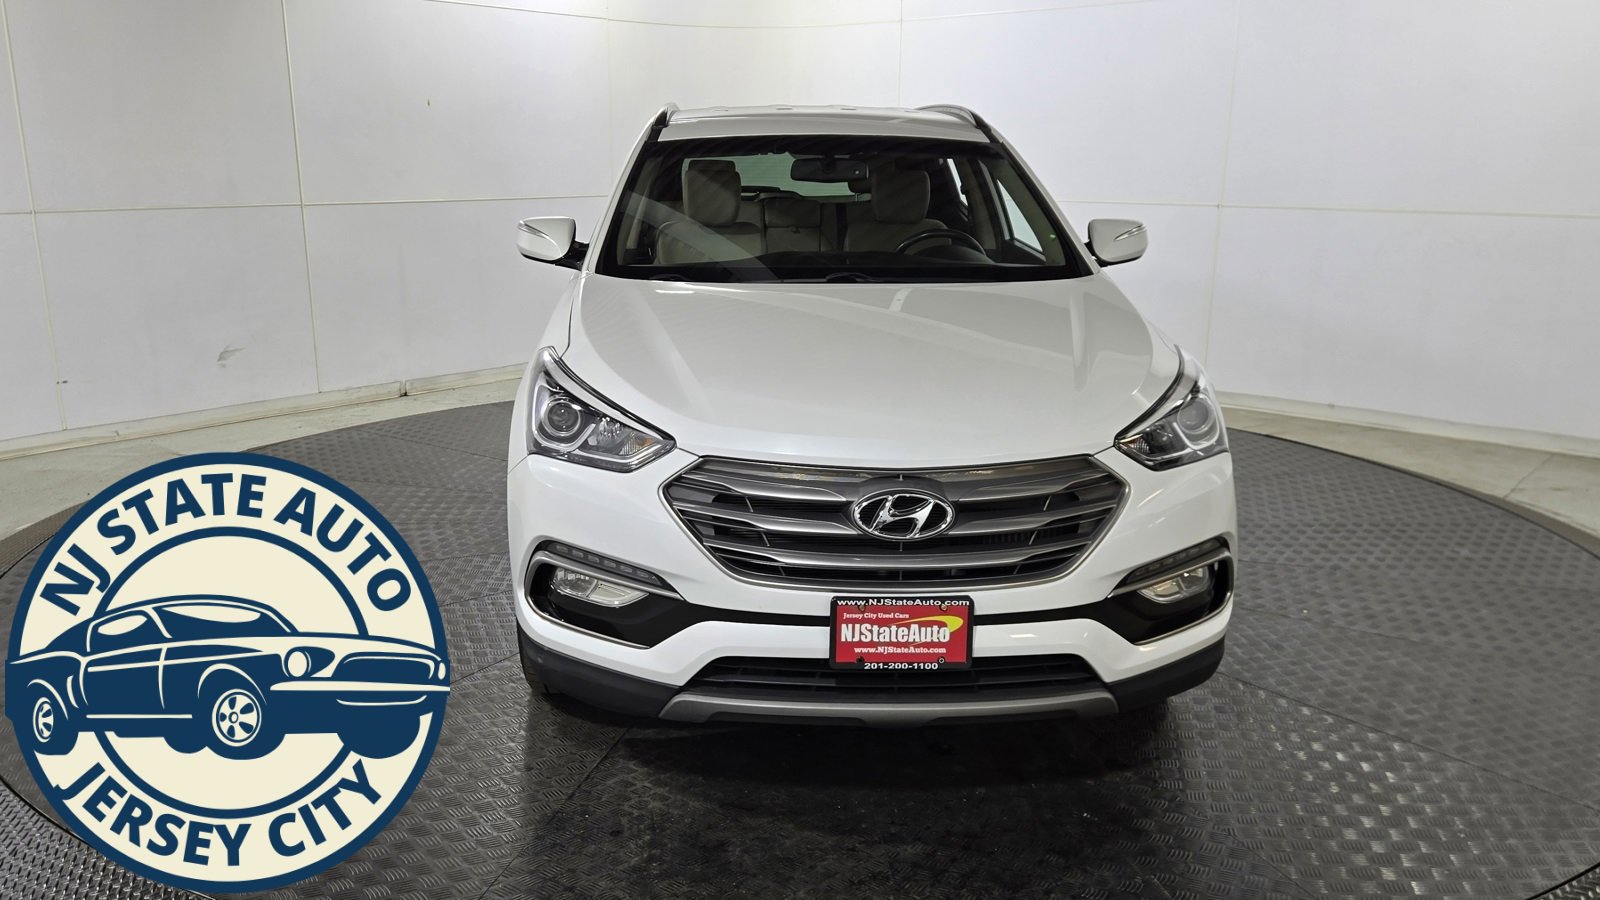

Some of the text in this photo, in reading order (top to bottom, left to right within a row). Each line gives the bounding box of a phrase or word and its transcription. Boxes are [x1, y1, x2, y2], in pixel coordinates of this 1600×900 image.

[837, 598, 970, 606] www.NJStateAuto.com
[843, 612, 863, 620] Jersey
[864, 612, 877, 620] City
[841, 623, 950, 642] NJStateAuto
[854, 646, 946, 654] www.NJStateAuto.com
[864, 662, 939, 670] 201-200-1100
